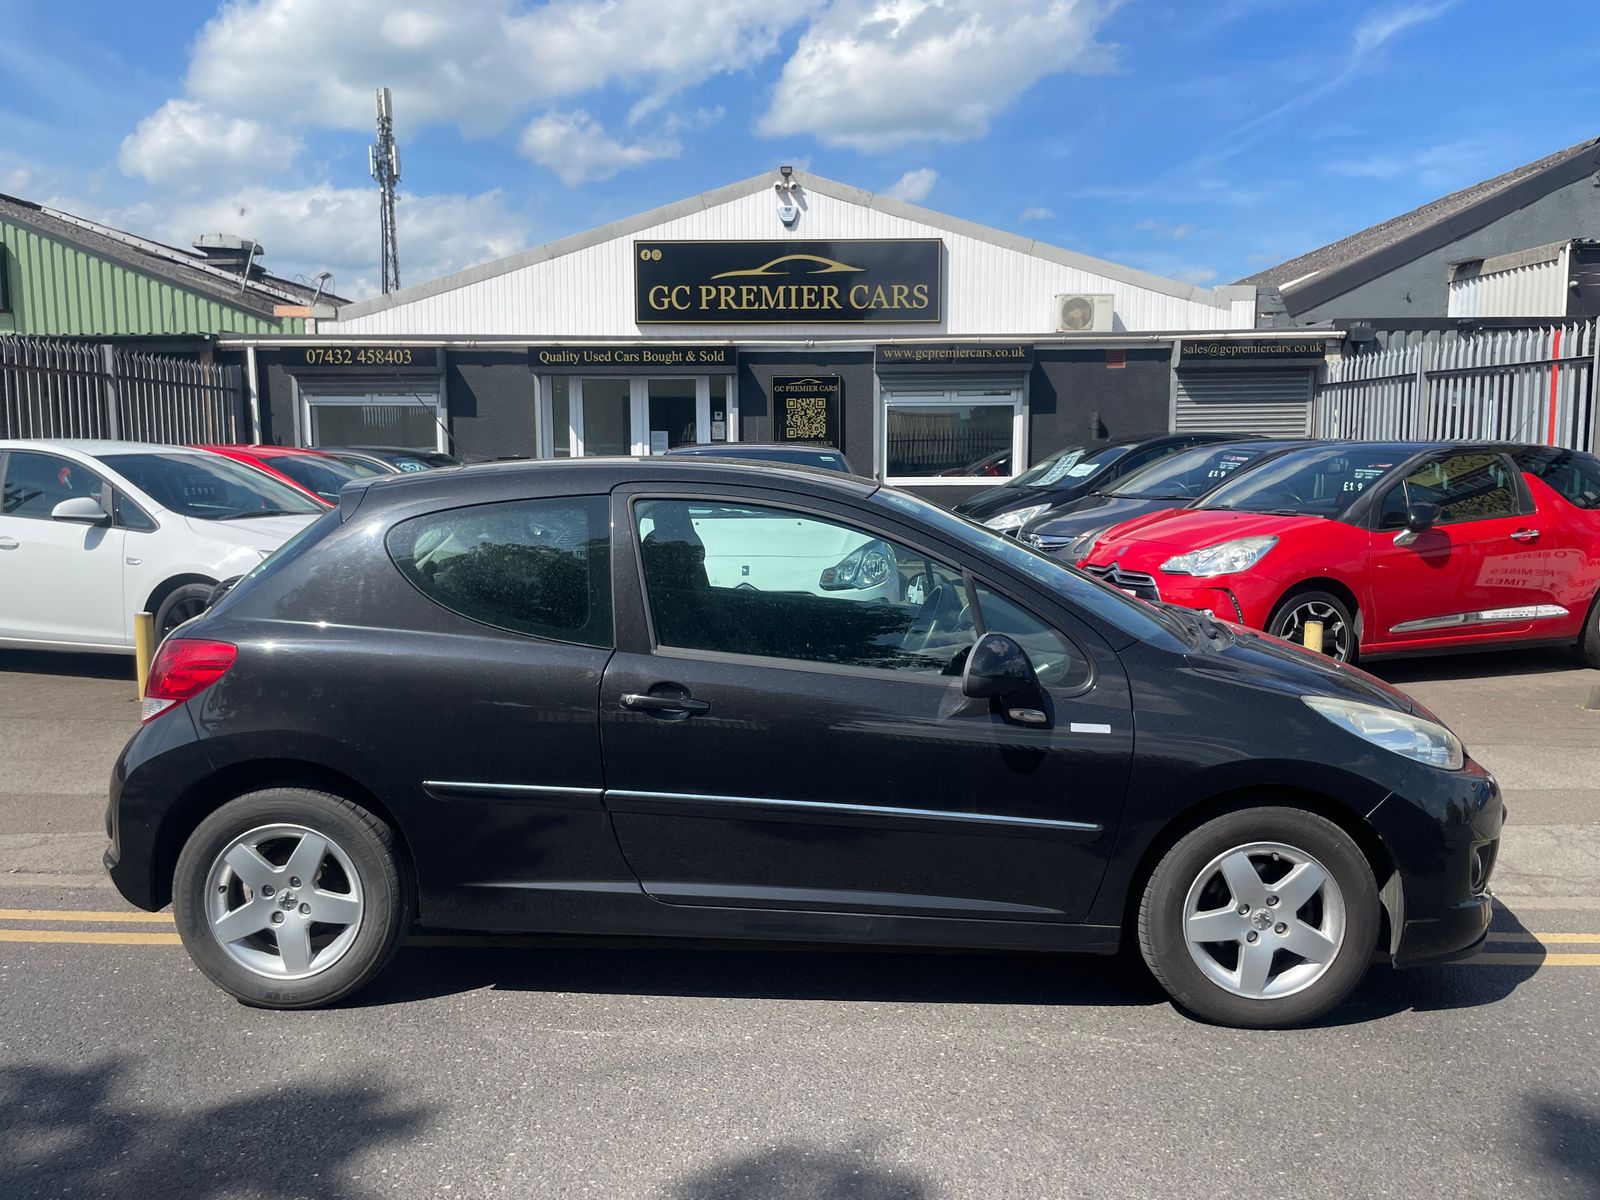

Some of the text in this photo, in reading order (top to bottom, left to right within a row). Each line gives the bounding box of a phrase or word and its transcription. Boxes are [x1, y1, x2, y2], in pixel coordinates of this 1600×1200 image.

[648, 284, 930, 311] GC PREMIER CARS
[306, 349, 412, 364] 07432 458403
[539, 350, 725, 364] Quality Used Cars Bought & Sold
[883, 346, 1026, 361] www.gcpremiercars.co.uk
[1183, 342, 1322, 357] sales@gcpremiercars.co.uk
